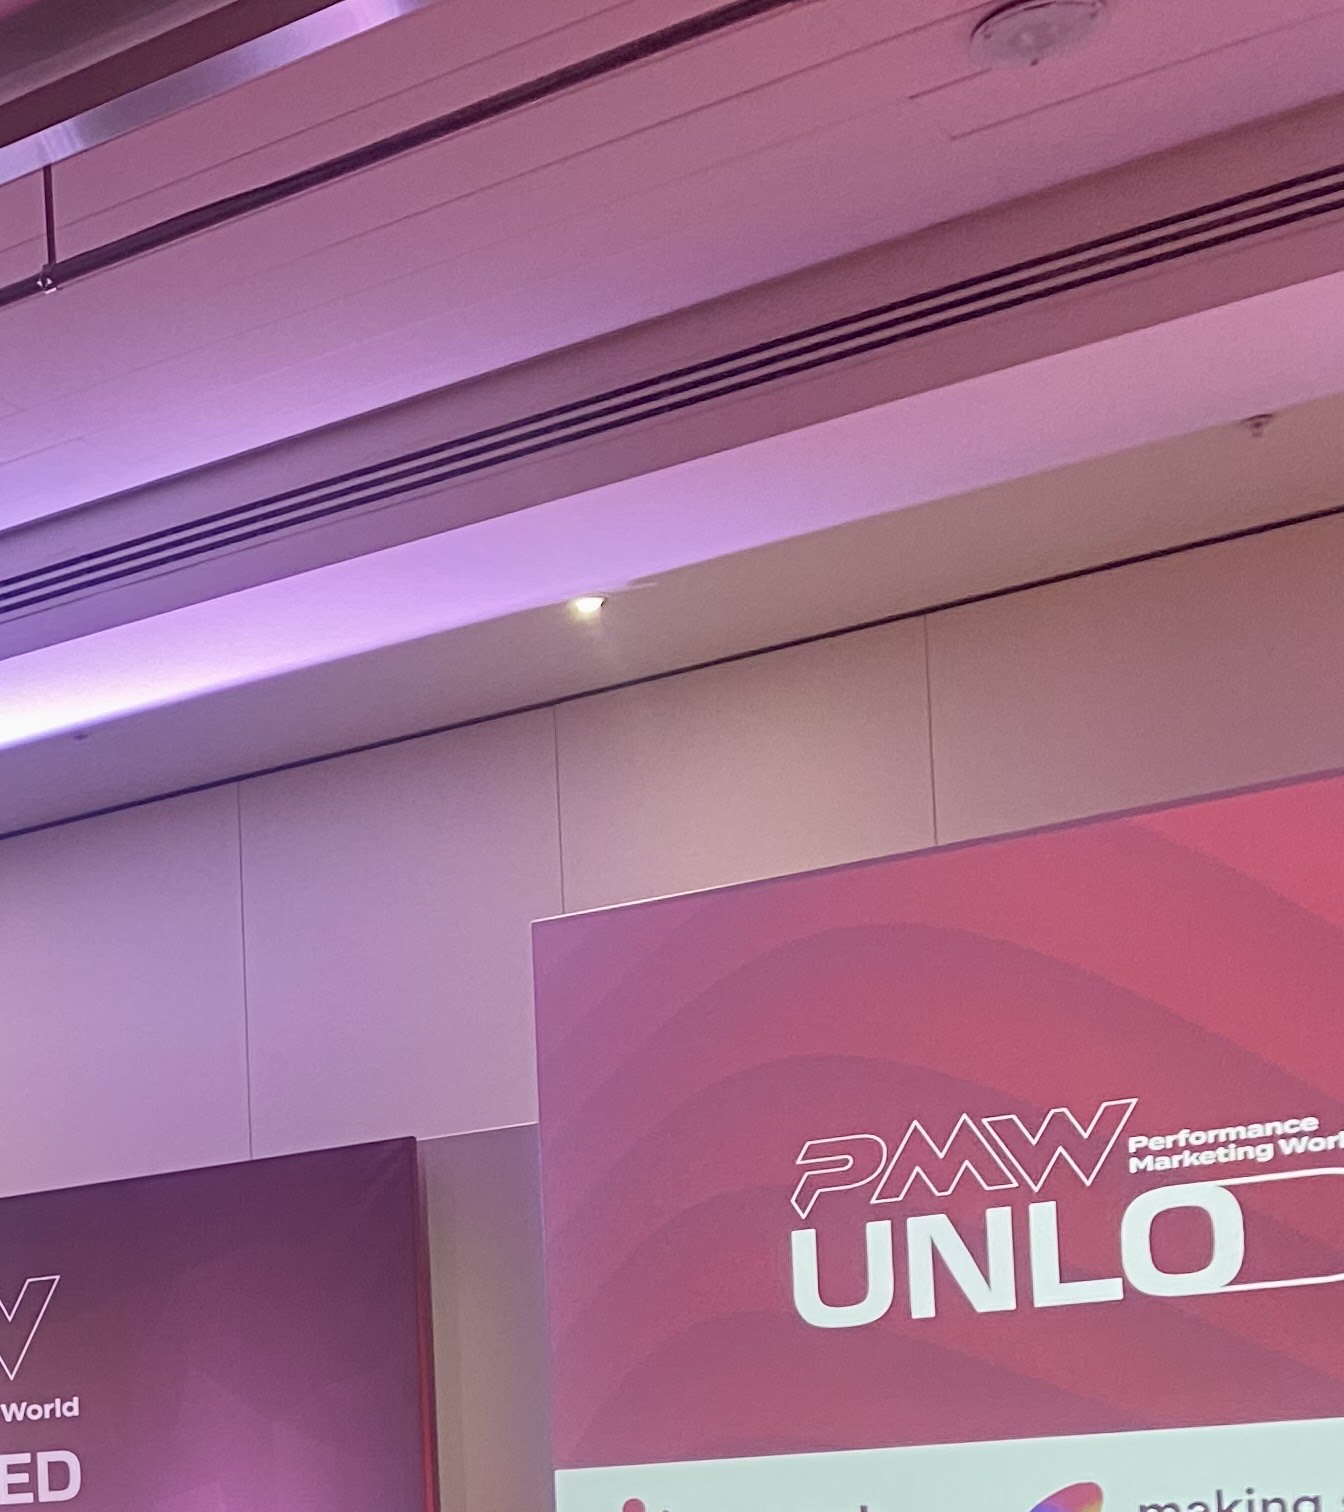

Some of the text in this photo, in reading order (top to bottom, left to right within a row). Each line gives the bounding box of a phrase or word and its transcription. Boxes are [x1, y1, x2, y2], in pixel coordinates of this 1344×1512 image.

[1128, 1116, 1320, 1153] Performance
[1129, 1131, 1344, 1174] Marketing Worl
[791, 1097, 1138, 1219] PMW
[791, 1183, 1247, 1329] UNLO
[0, 1397, 80, 1422] World
